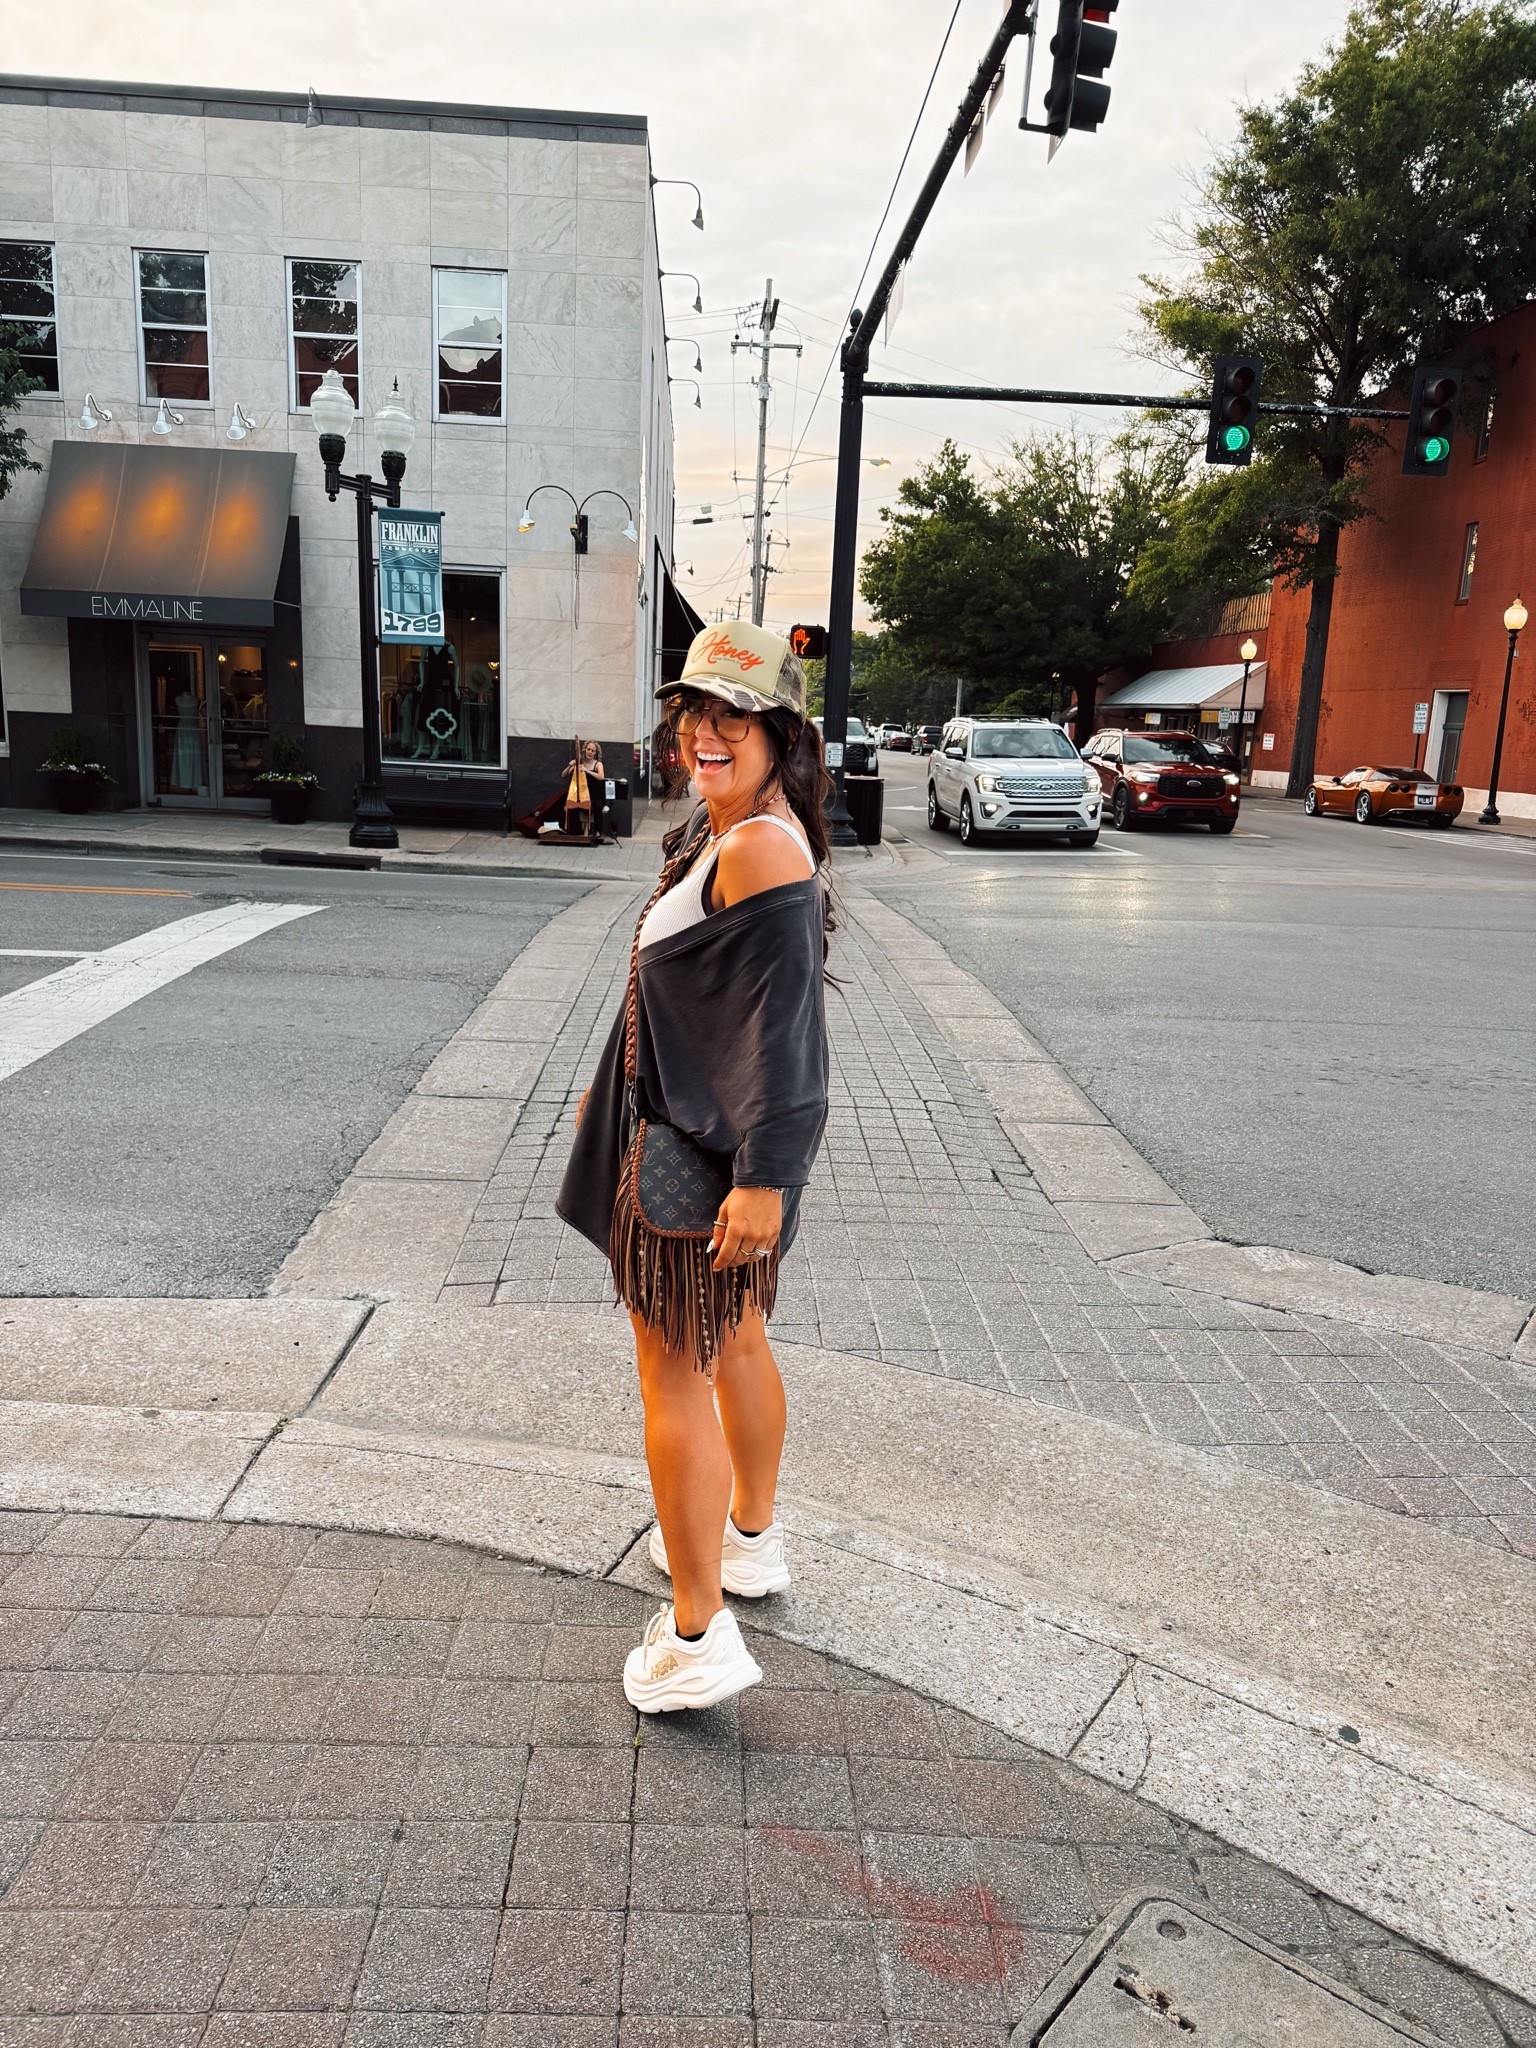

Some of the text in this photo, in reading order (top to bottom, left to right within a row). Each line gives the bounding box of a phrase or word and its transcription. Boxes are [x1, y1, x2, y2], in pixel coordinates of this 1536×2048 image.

[381, 522, 438, 544] FRANKLIN
[91, 596, 203, 621] EMMALINE
[384, 611, 441, 633] 1799
[692, 631, 764, 671] Honey
[651, 1654, 678, 1680] HOKA
